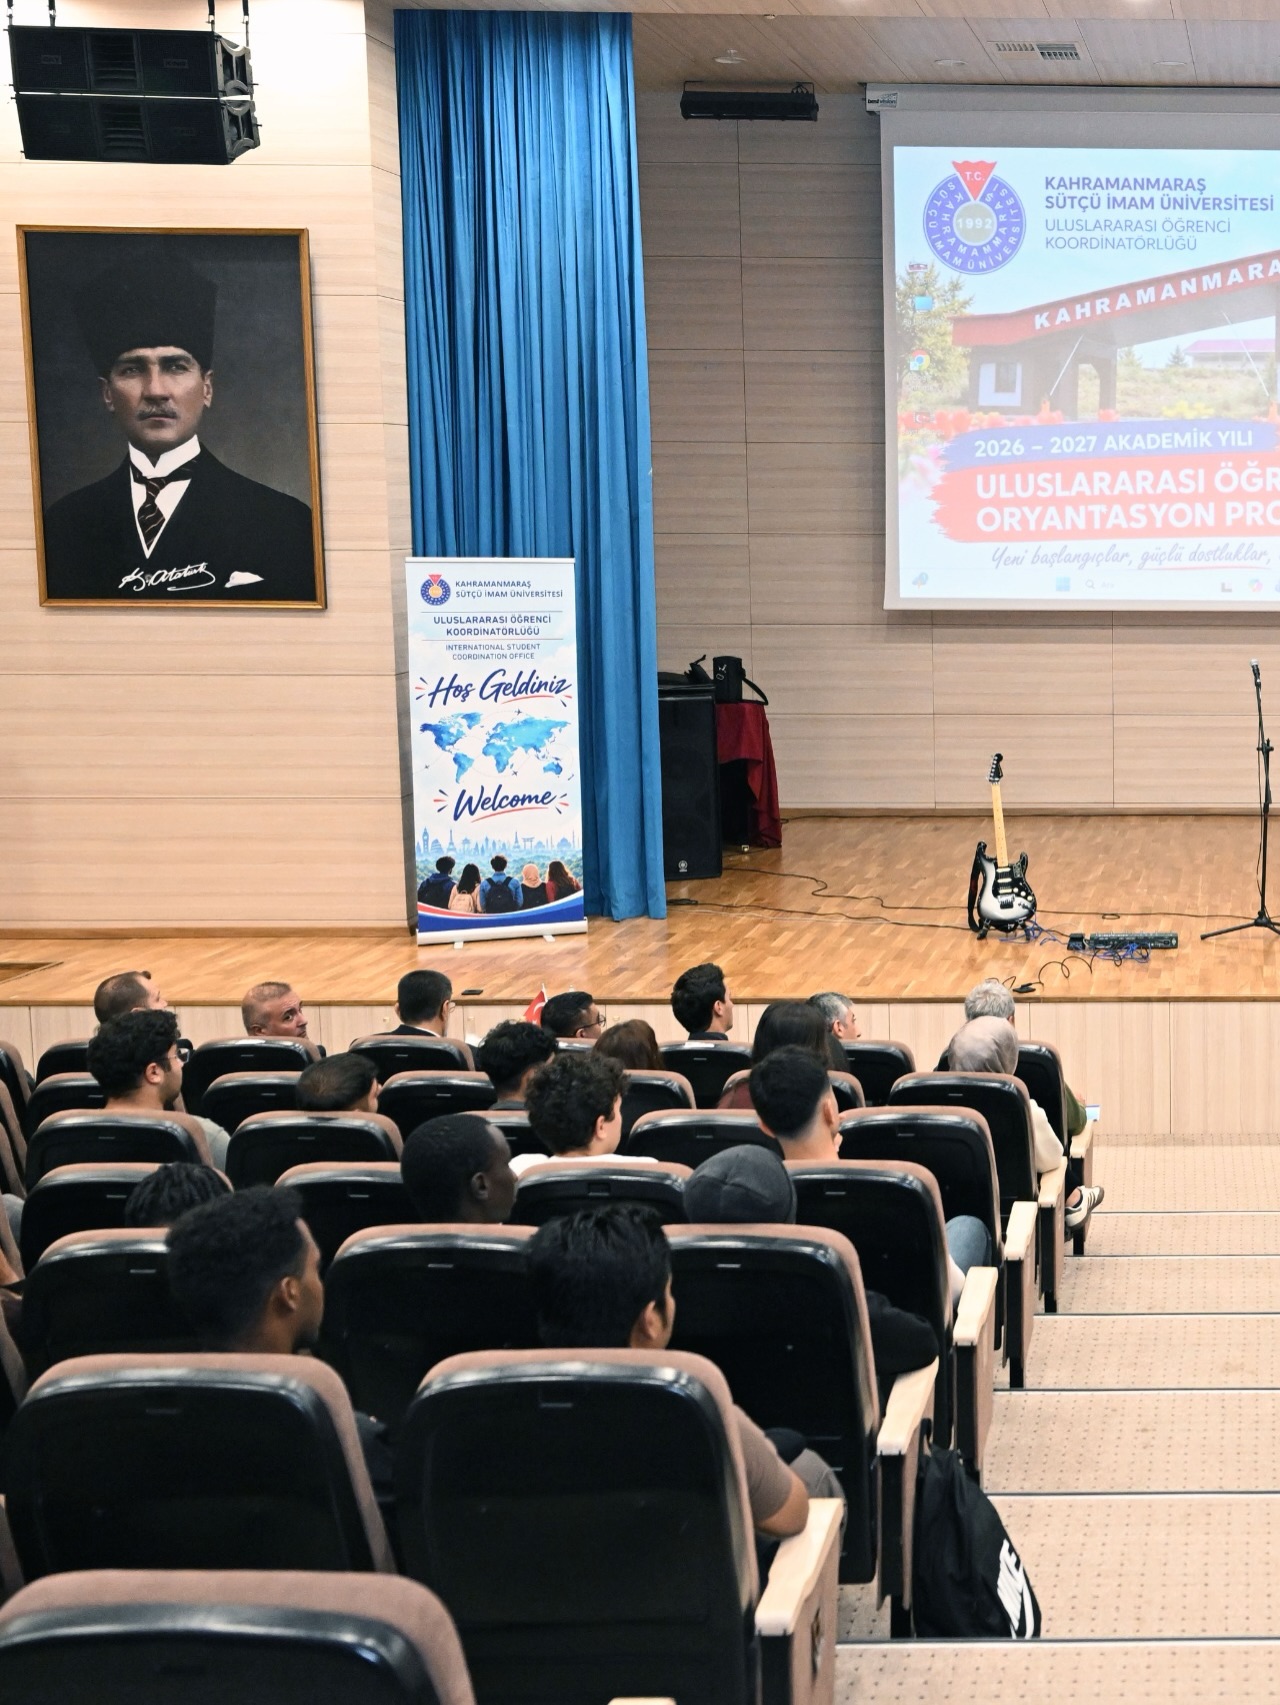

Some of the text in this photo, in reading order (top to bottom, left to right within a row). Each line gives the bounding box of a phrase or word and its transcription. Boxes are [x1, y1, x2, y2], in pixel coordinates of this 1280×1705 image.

[965, 171, 985, 181] T.C.
[1045, 177, 1206, 193] KAHRAMANMARAŞ
[1045, 193, 1274, 212] SÜTÇÜ İMAM ÜNİVERSİTESİ
[957, 218, 993, 230] 1992
[1045, 216, 1231, 233] ULUSLARARASI ÖĞRENCİ
[1045, 234, 1197, 251] KOORDİNATÖRLÜĞÜ
[975, 438, 1025, 458] 2026
[1050, 435, 1097, 454] 2027
[1104, 427, 1213, 451] AKADEMİK
[1217, 430, 1253, 448] YILI
[976, 468, 1205, 499] ULUSLARARASI
[977, 502, 1215, 533] ORYANTASYON
[991, 545, 1026, 569] Yeni
[1030, 544, 1133, 569] başlangıçlar,
[1138, 544, 1182, 570] güçlü
[1188, 541, 1272, 566] dostluklar,
[455, 589, 563, 599] SÜTÇÜ İMAM ÜNİVERSİTESİ
[433, 613, 551, 624] ULUSLARARASI ÖĞRENCİ
[446, 626, 540, 636] KOORDİNATÖRLÜĞÜ
[428, 668, 573, 708] Hoş Geldiniz
[453, 784, 558, 822] Welcome
